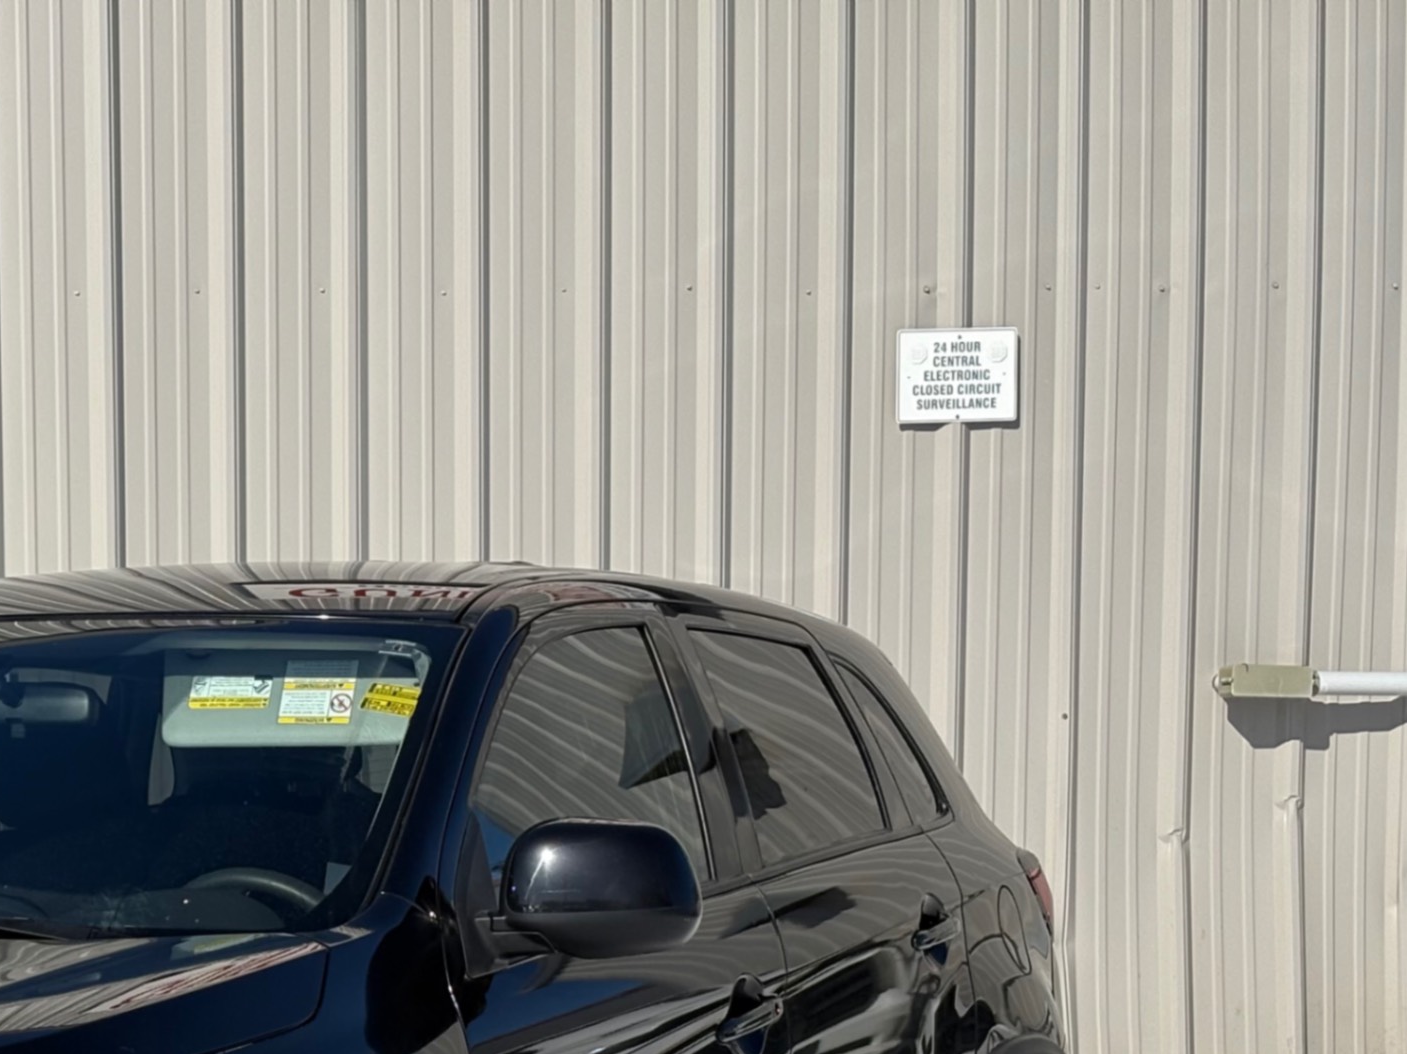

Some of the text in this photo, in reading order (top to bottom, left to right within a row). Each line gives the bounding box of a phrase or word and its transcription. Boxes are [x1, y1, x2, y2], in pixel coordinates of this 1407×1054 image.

[933, 341, 981, 353] 24 HOUR
[933, 355, 982, 367] CENTRAL
[923, 369, 991, 381] ELECTRONIC
[912, 383, 1001, 396] CLOSED CIRCUIT
[916, 397, 997, 410] SURVEILLANCE
